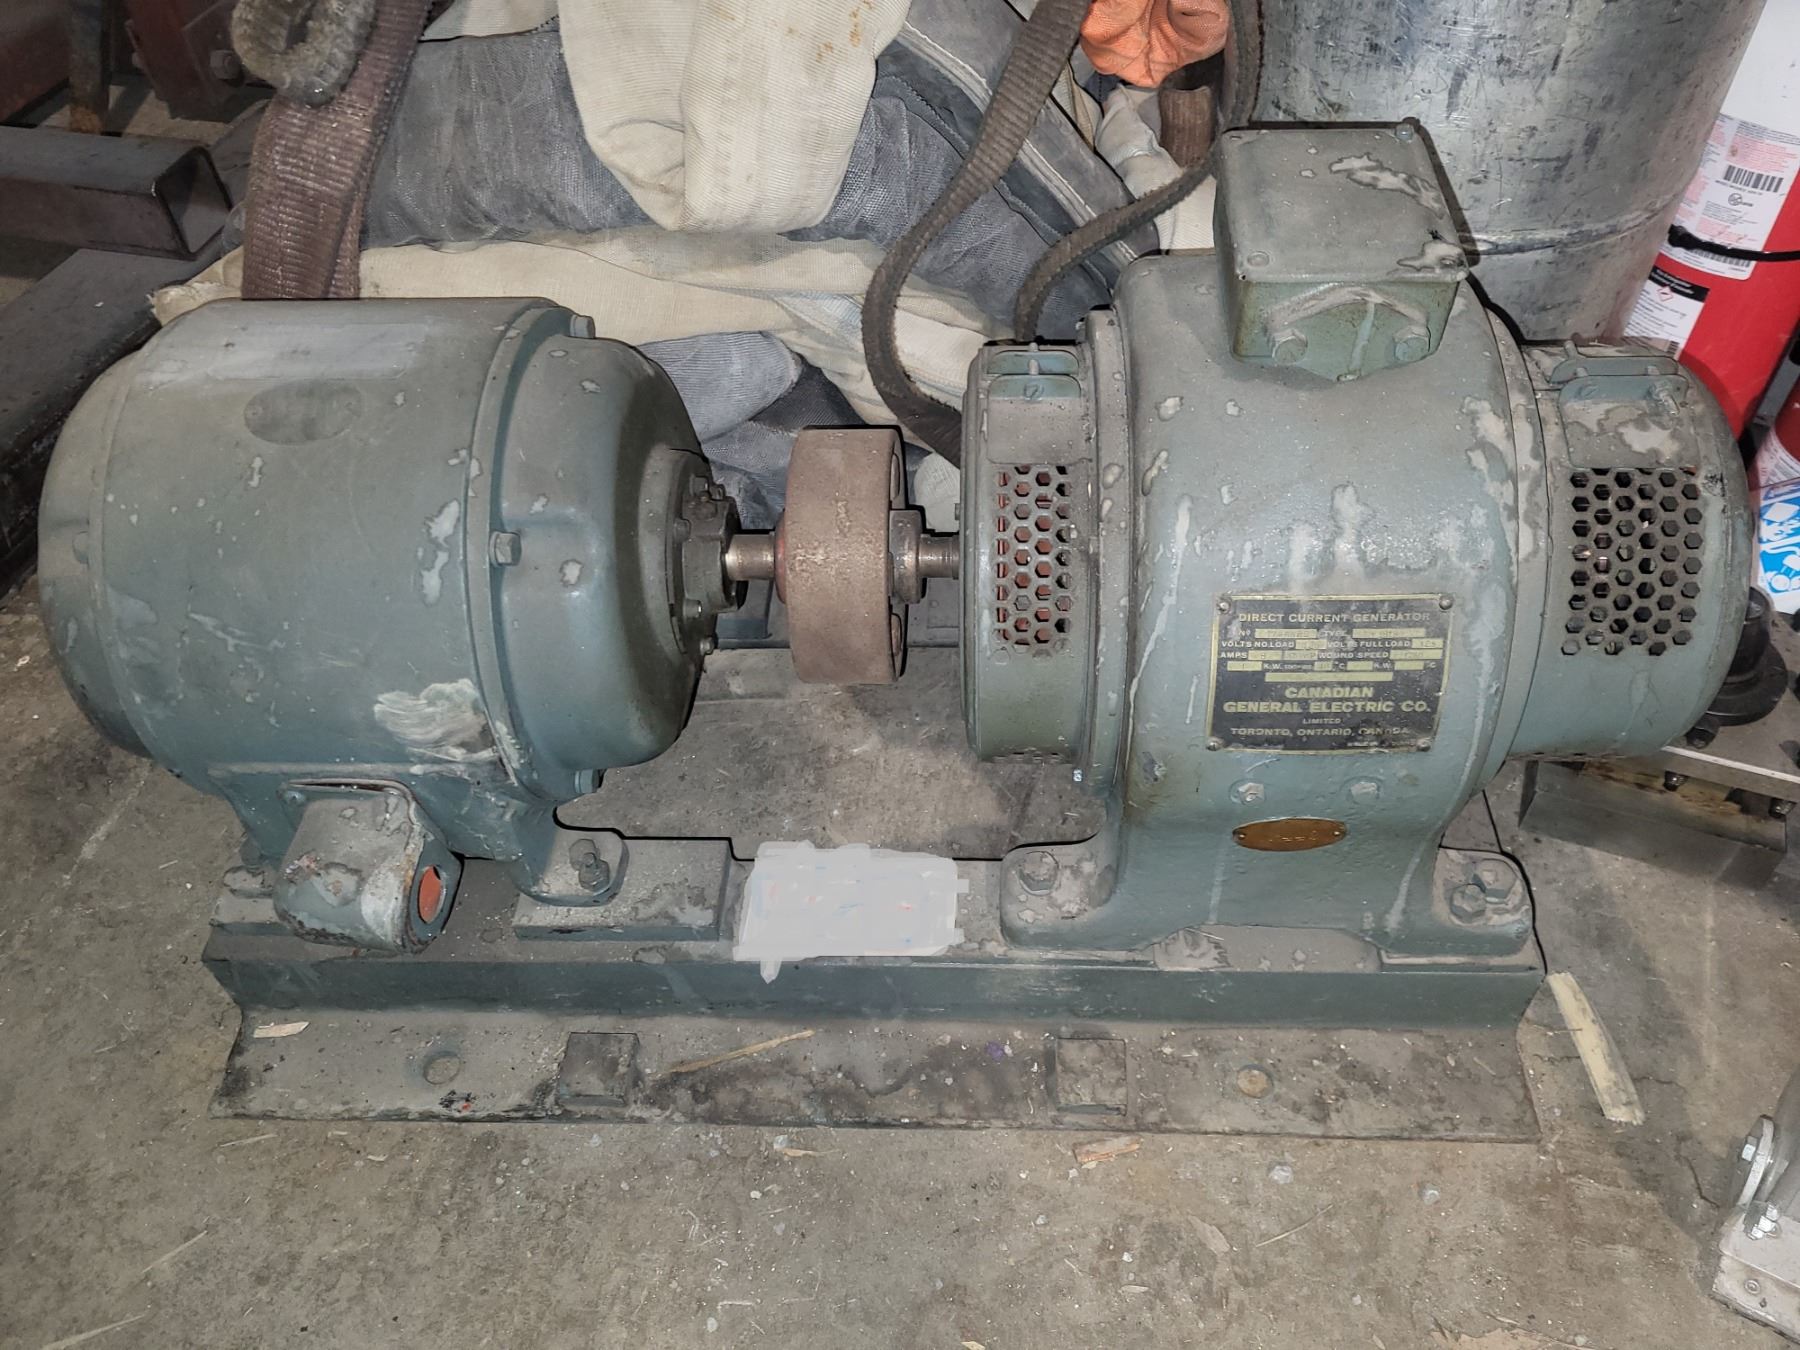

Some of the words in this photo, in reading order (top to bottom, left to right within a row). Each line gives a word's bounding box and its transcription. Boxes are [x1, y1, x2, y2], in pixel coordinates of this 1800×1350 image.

[1239, 613, 1285, 623] DIRECT
[1288, 613, 1349, 623] CURRENT
[1353, 612, 1431, 622] GENERATOR
[1360, 640, 1384, 648] FULL
[1385, 640, 1412, 648] LOAD
[1220, 652, 1248, 660] AMPS
[1319, 652, 1355, 660] WOUND
[1357, 651, 1390, 660] SPEED
[1284, 687, 1374, 699] CANADIAN
[1223, 701, 1303, 713] GENERAL
[1309, 701, 1394, 713] ELECTRIC
[1401, 700, 1432, 713] CO.
[1230, 728, 1293, 737] TORONTO,
[1296, 728, 1355, 737] ONTARIO,
